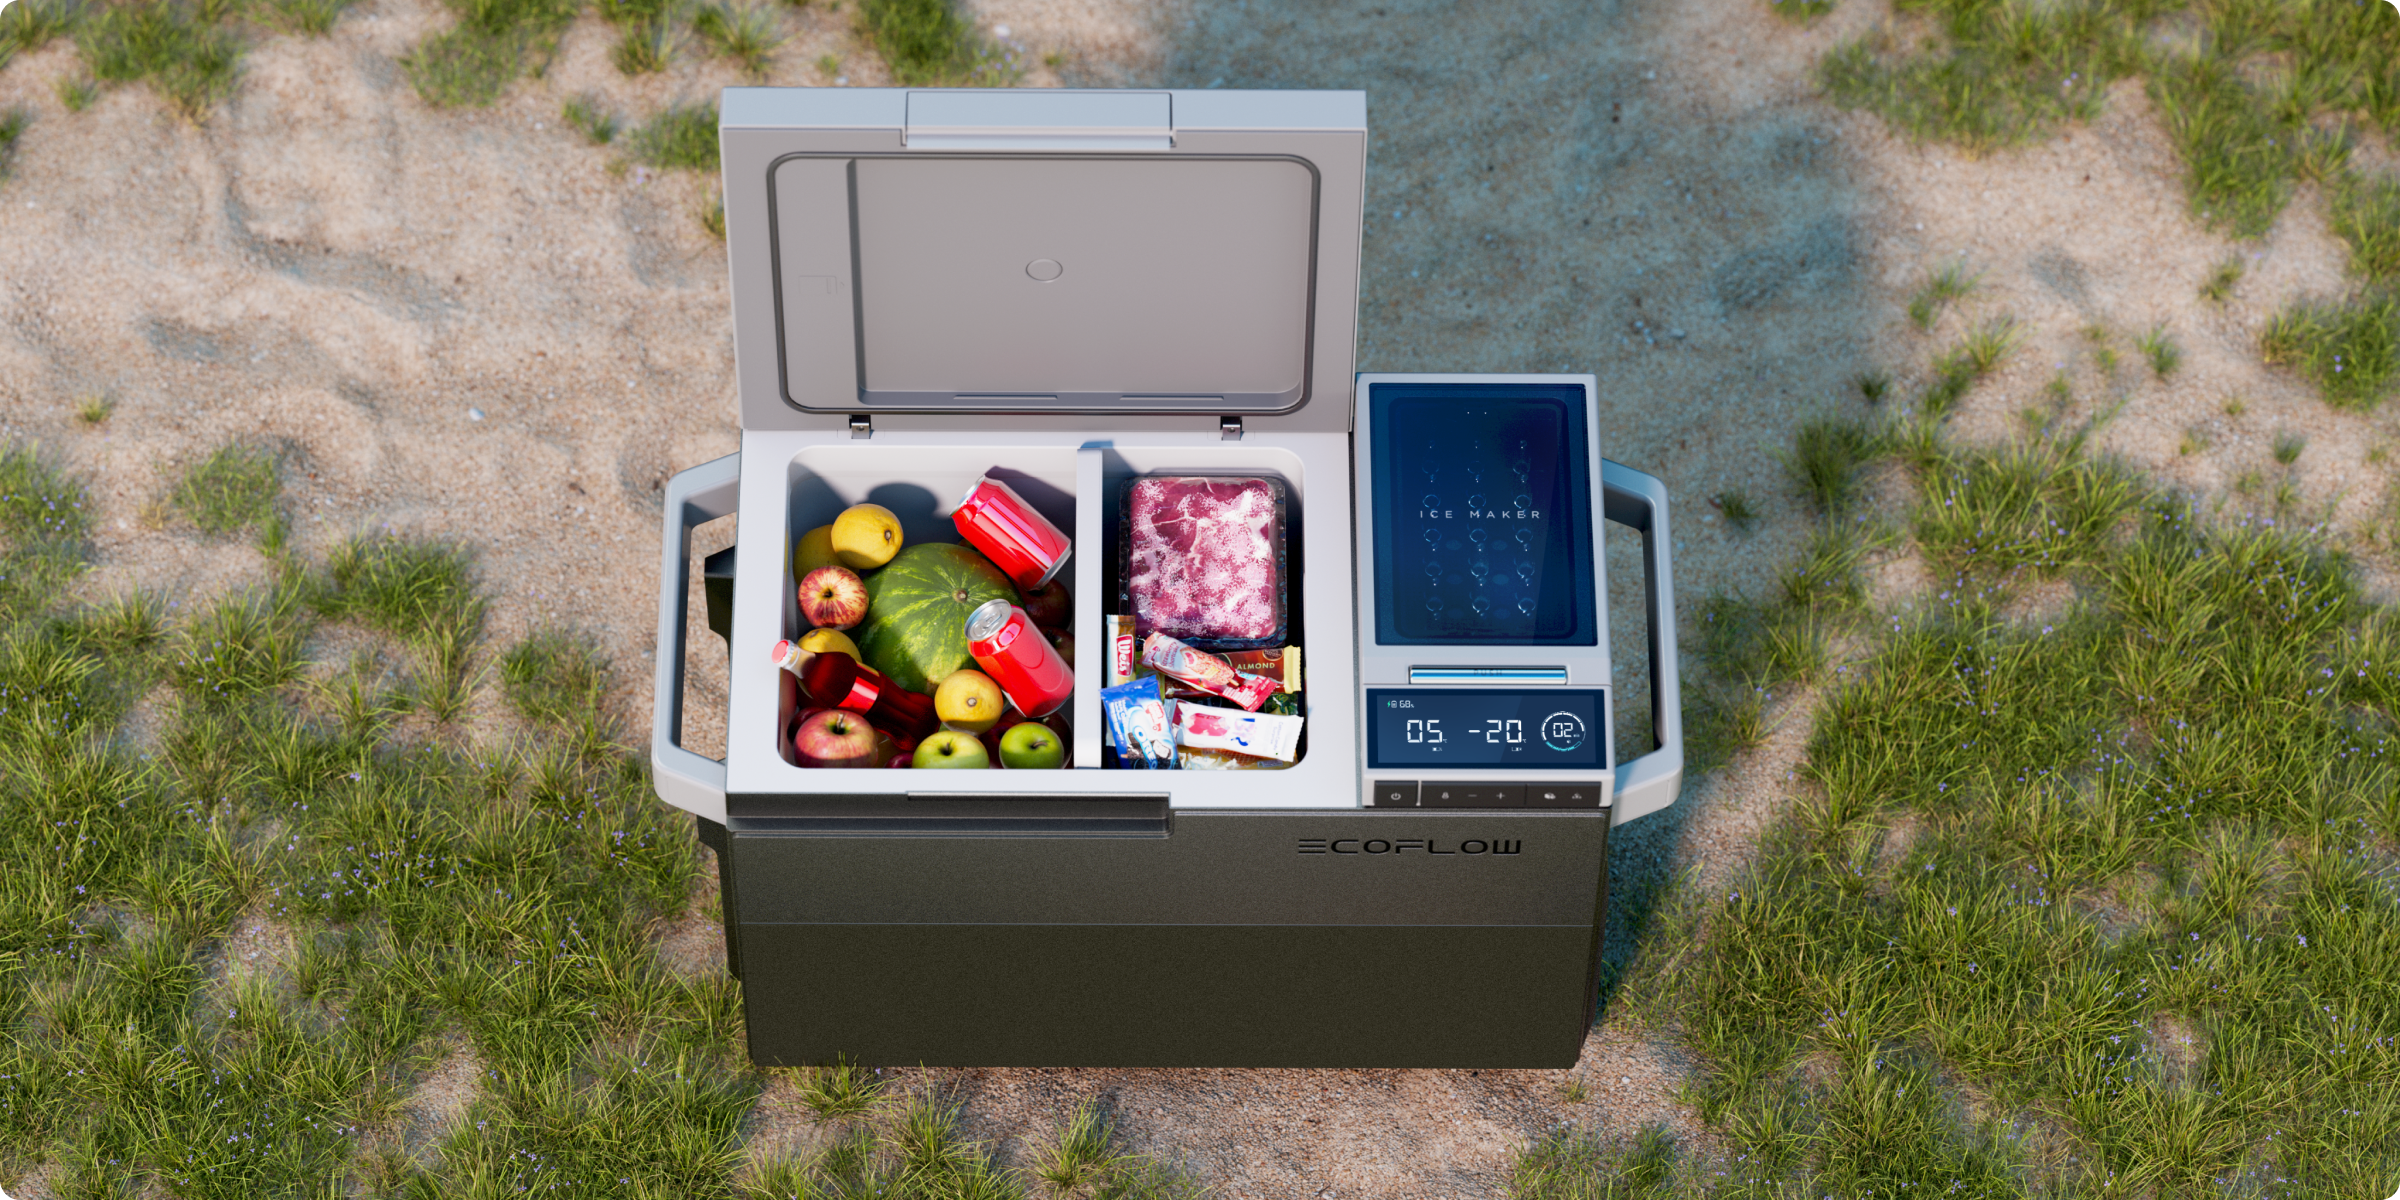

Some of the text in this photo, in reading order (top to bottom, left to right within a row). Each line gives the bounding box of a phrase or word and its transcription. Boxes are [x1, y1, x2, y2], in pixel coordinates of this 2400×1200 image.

[1420, 510, 1540, 519] ICE MAKER
[1117, 639, 1132, 672] Weis
[1236, 662, 1276, 671] ALMOND
[1553, 722, 1574, 738] 02
[1298, 839, 1522, 855] ECOFLOW
